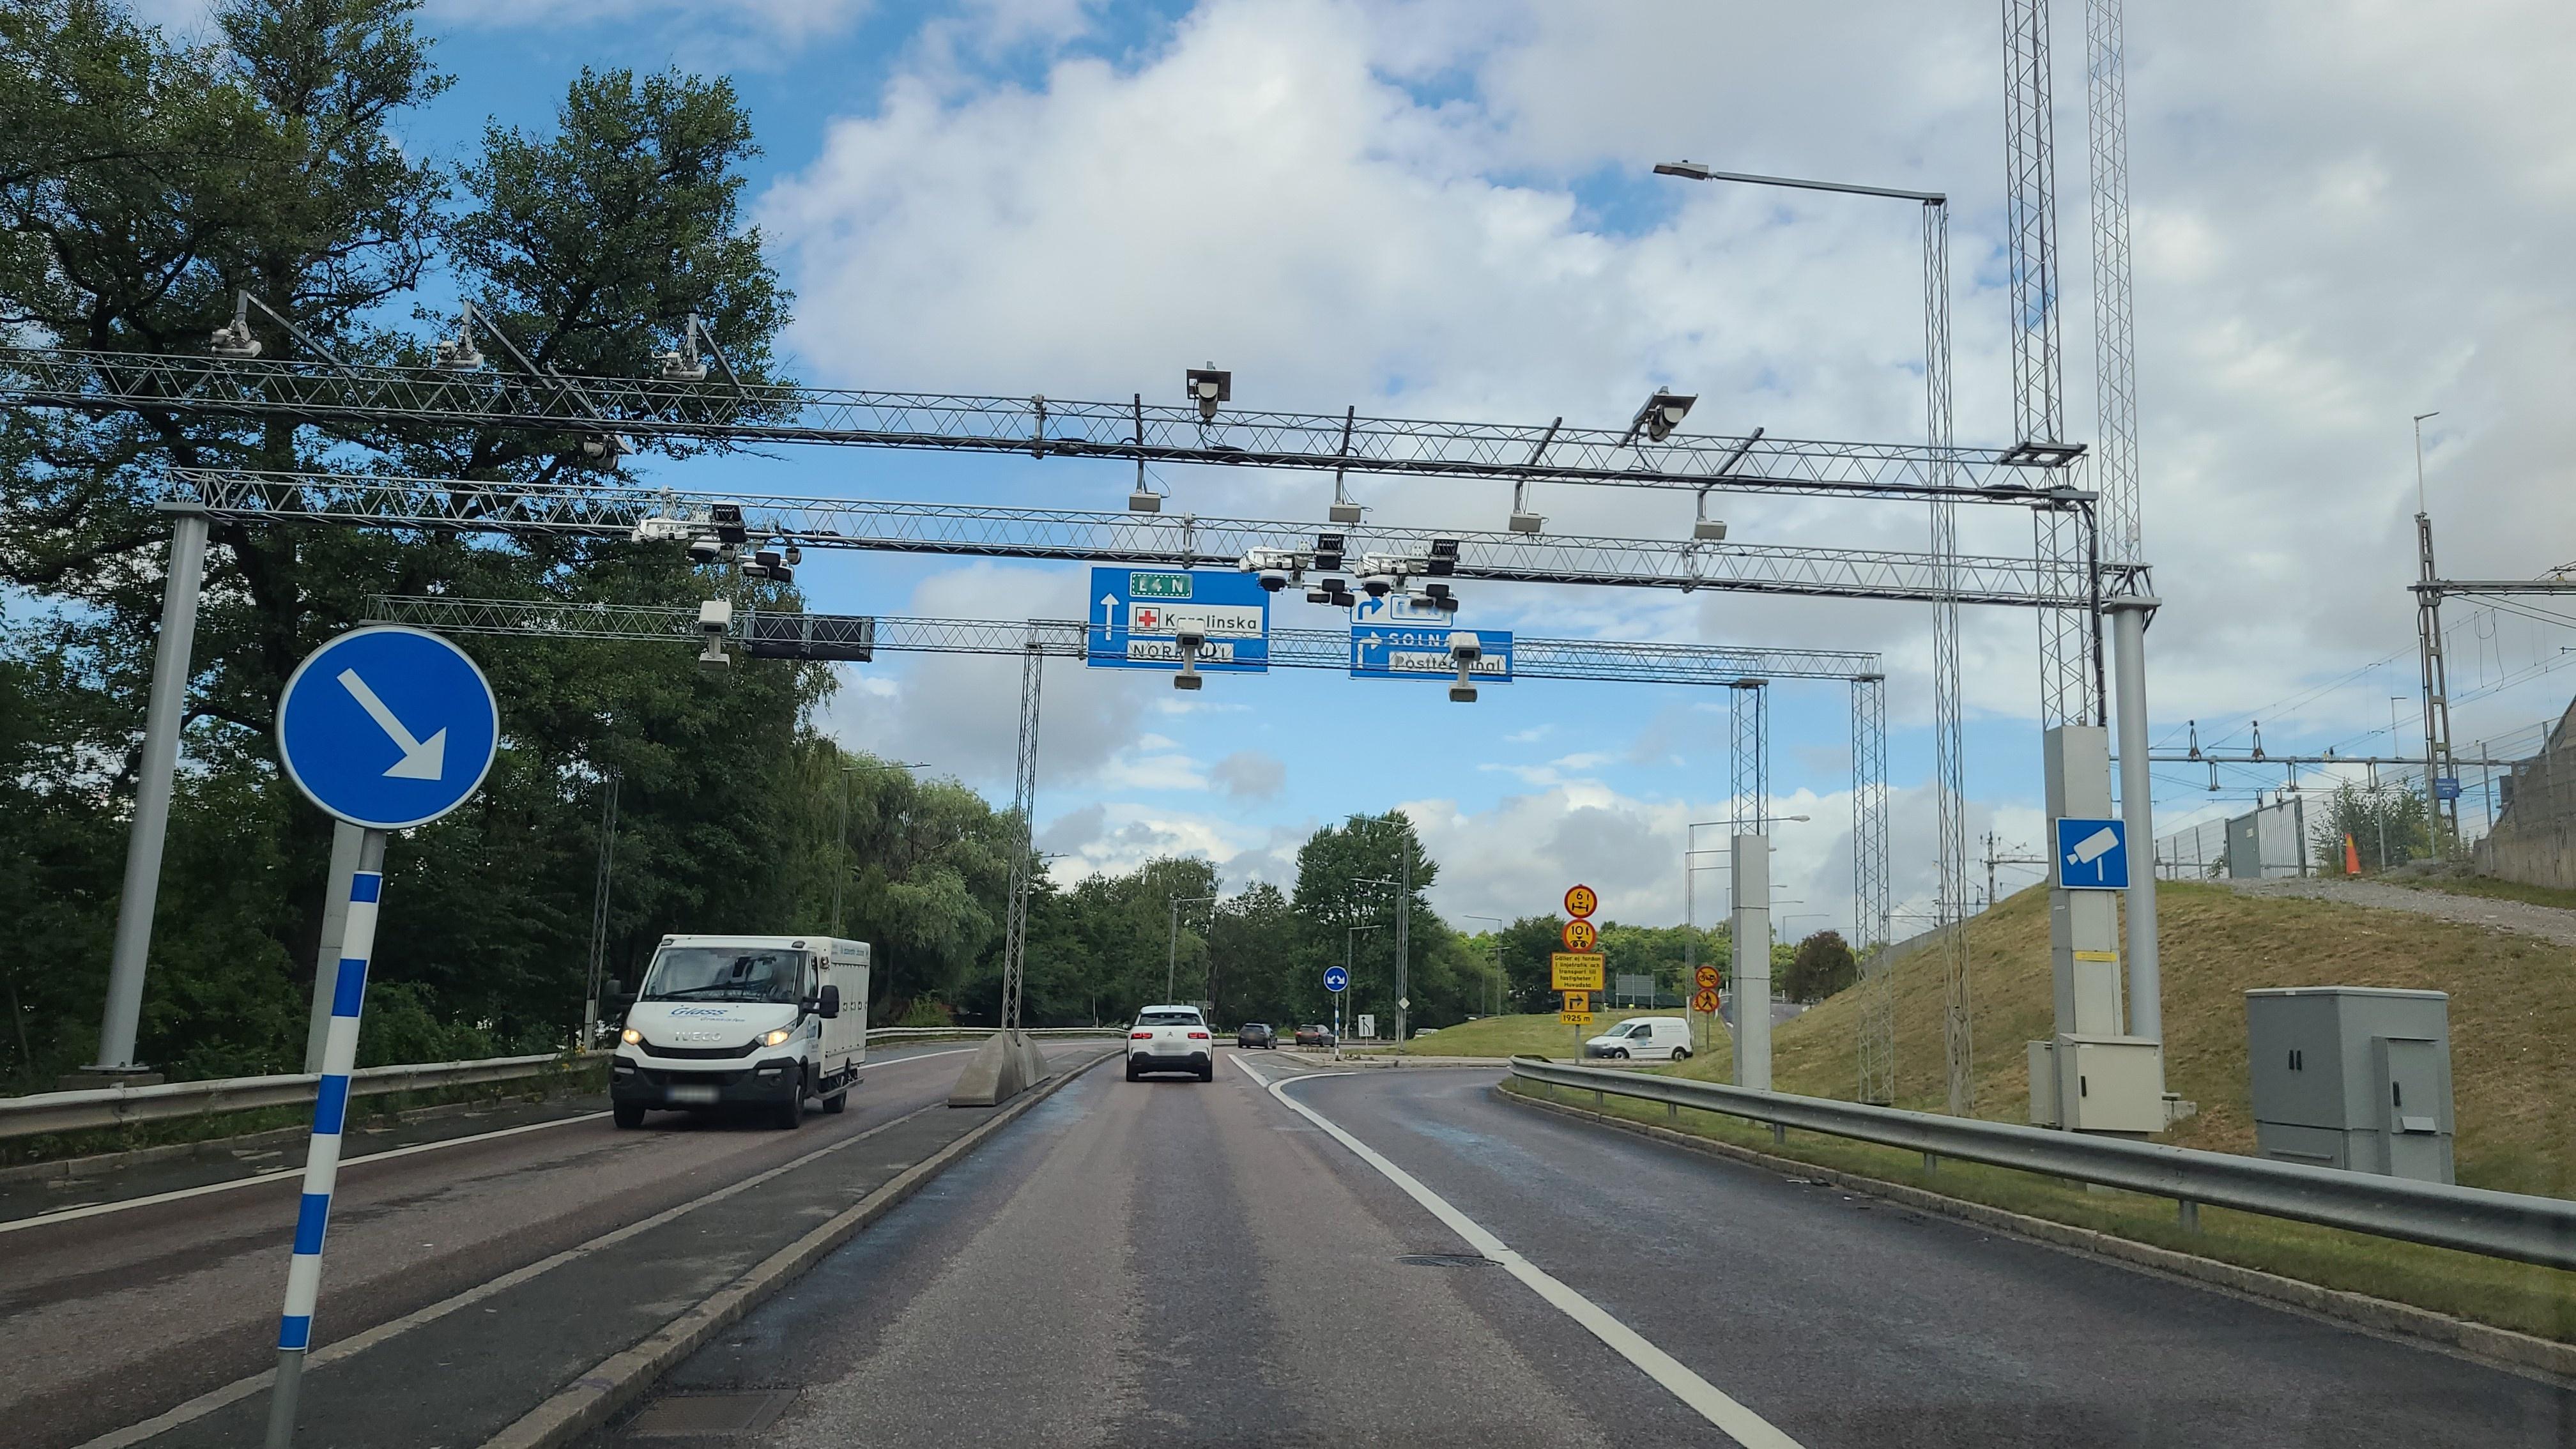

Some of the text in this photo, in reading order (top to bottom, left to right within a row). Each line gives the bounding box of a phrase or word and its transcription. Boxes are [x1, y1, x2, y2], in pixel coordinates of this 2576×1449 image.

[1165, 613, 1257, 629] Klinska
[1576, 891, 1583, 900] 6
[1572, 925, 1583, 935] 10
[675, 1032, 721, 1041] IVECO
